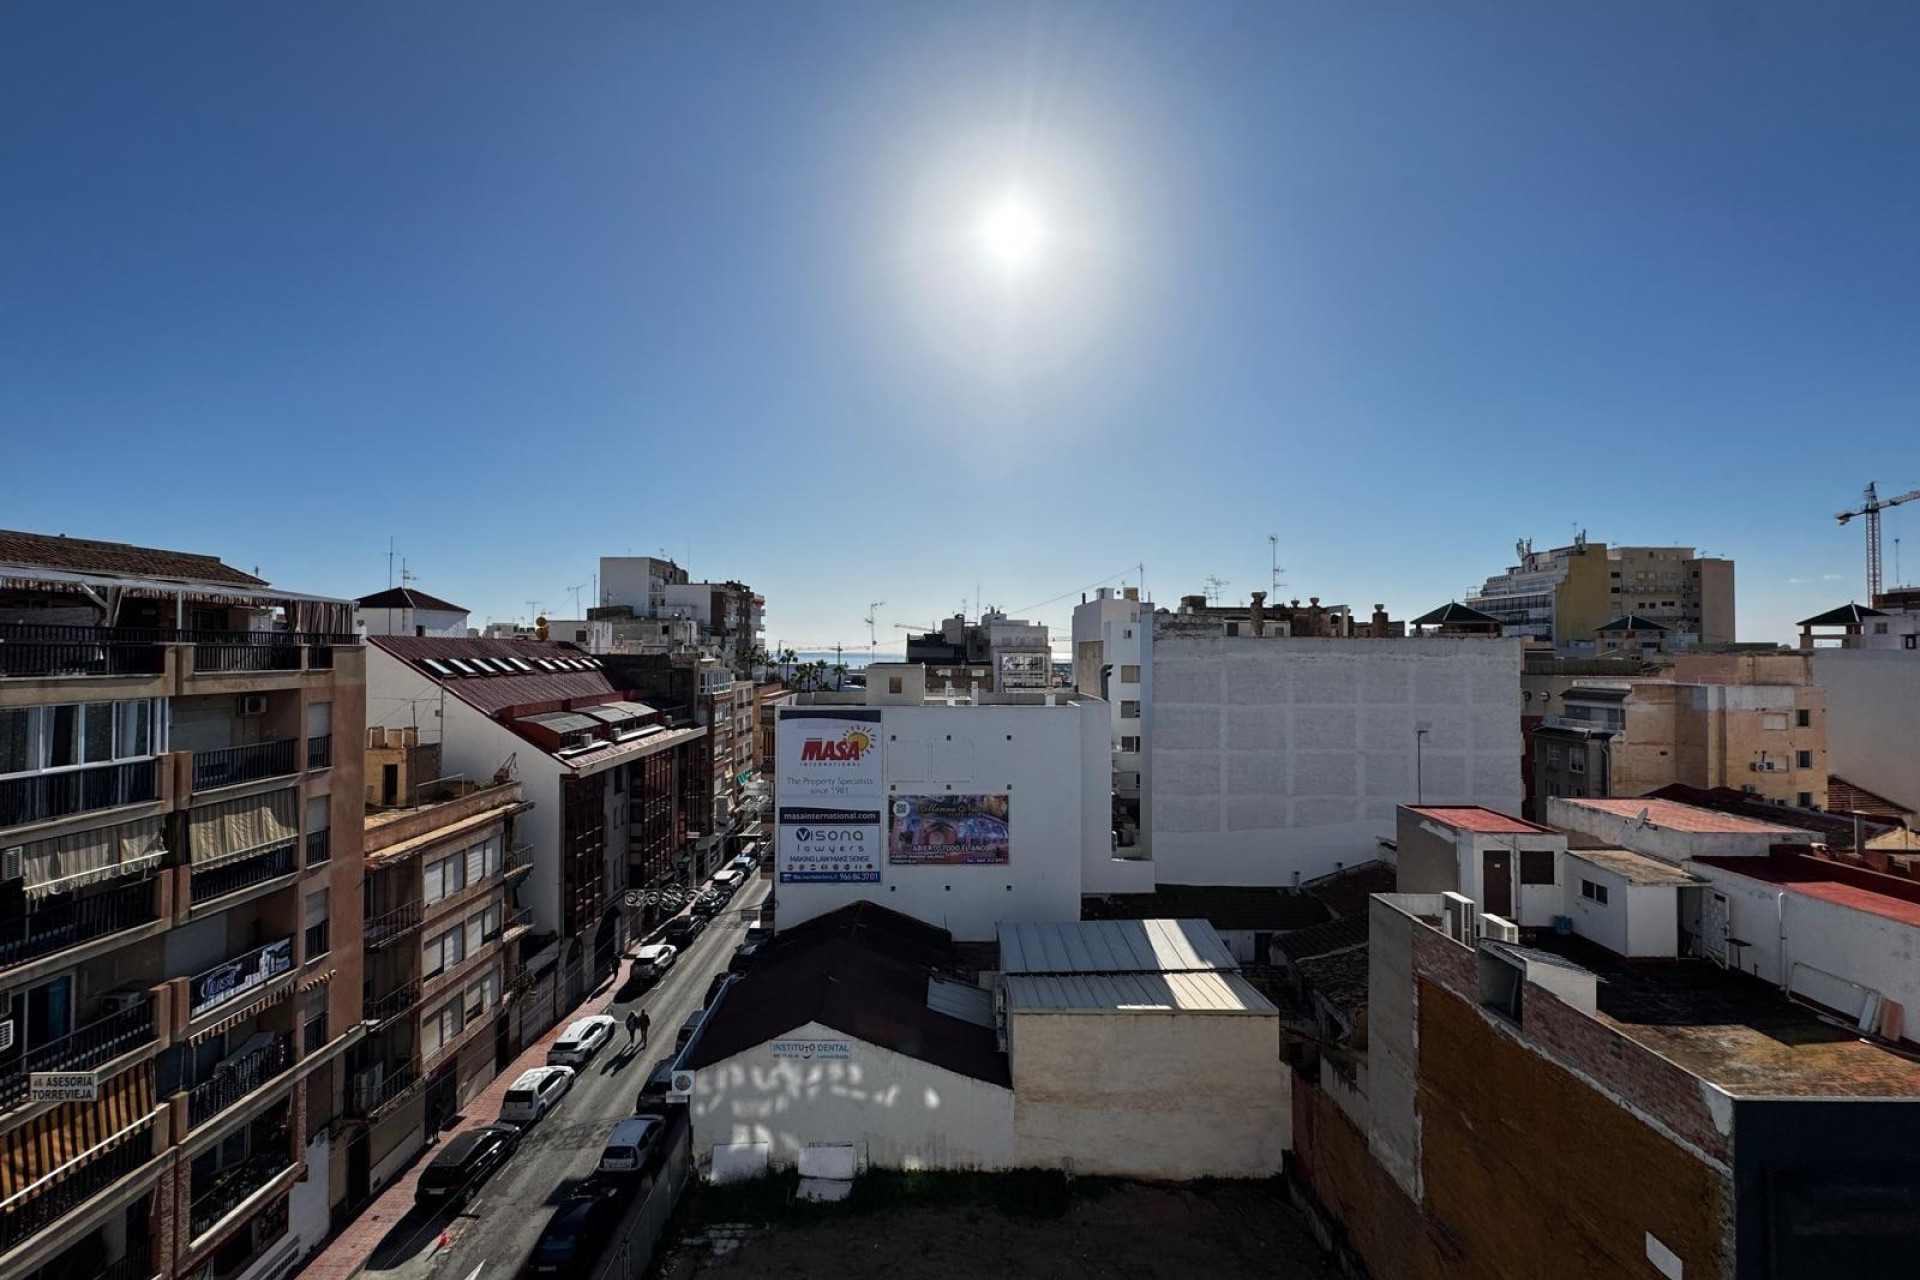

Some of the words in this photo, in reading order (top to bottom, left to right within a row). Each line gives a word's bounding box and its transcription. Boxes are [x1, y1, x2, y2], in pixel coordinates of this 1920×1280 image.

[801, 738, 860, 761] MASA
[784, 812, 876, 820] masainternational.com
[817, 1043, 849, 1052] DENTAL
[47, 1076, 92, 1087] ASESORIA
[32, 1089, 93, 1100] TORREVIEJA
